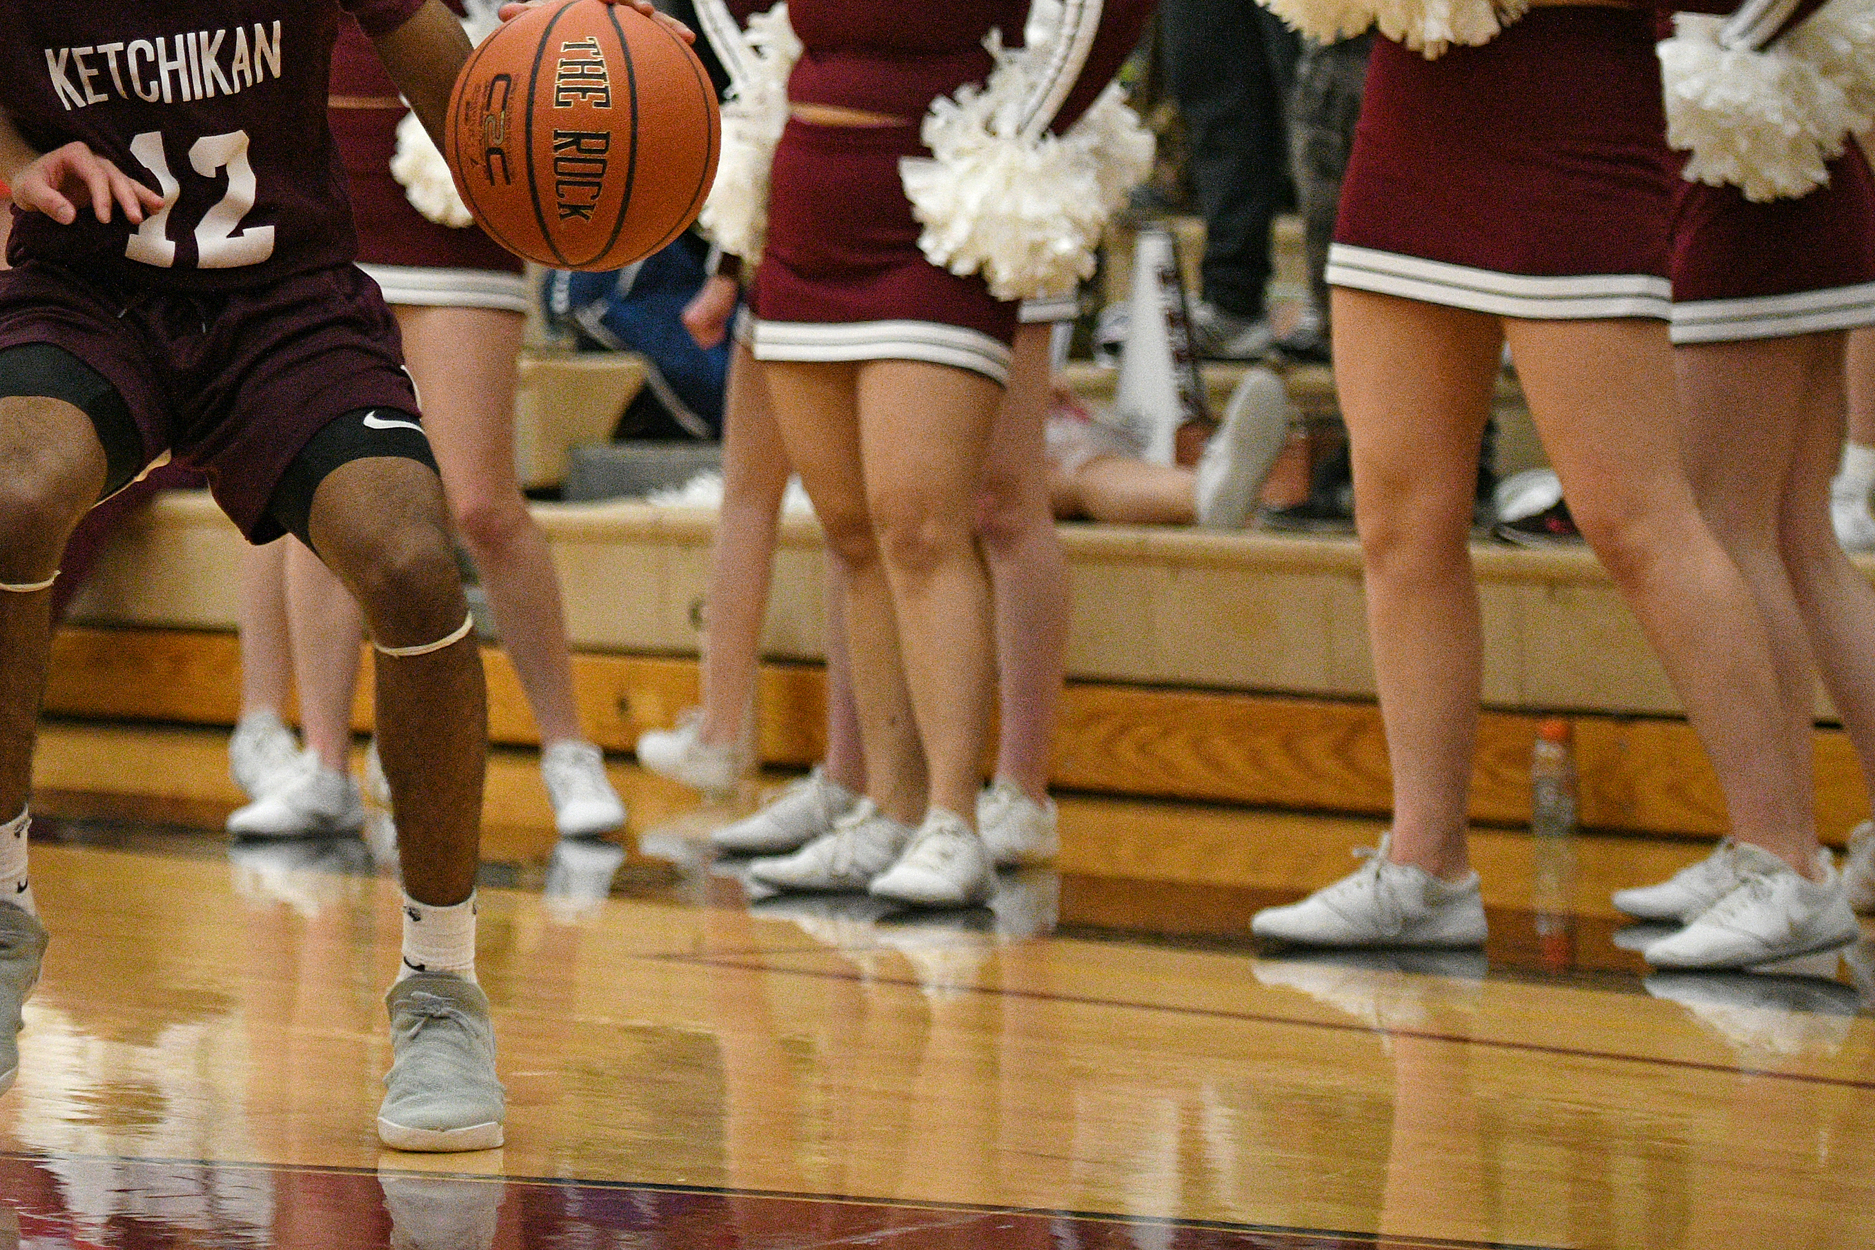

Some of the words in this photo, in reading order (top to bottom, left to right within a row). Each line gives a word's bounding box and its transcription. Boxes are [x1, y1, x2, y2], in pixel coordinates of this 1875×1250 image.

[45, 20, 281, 111] KETCHIKAN
[553, 36, 612, 109] THE
[125, 130, 275, 269] 12
[553, 128, 611, 223] ROCK
